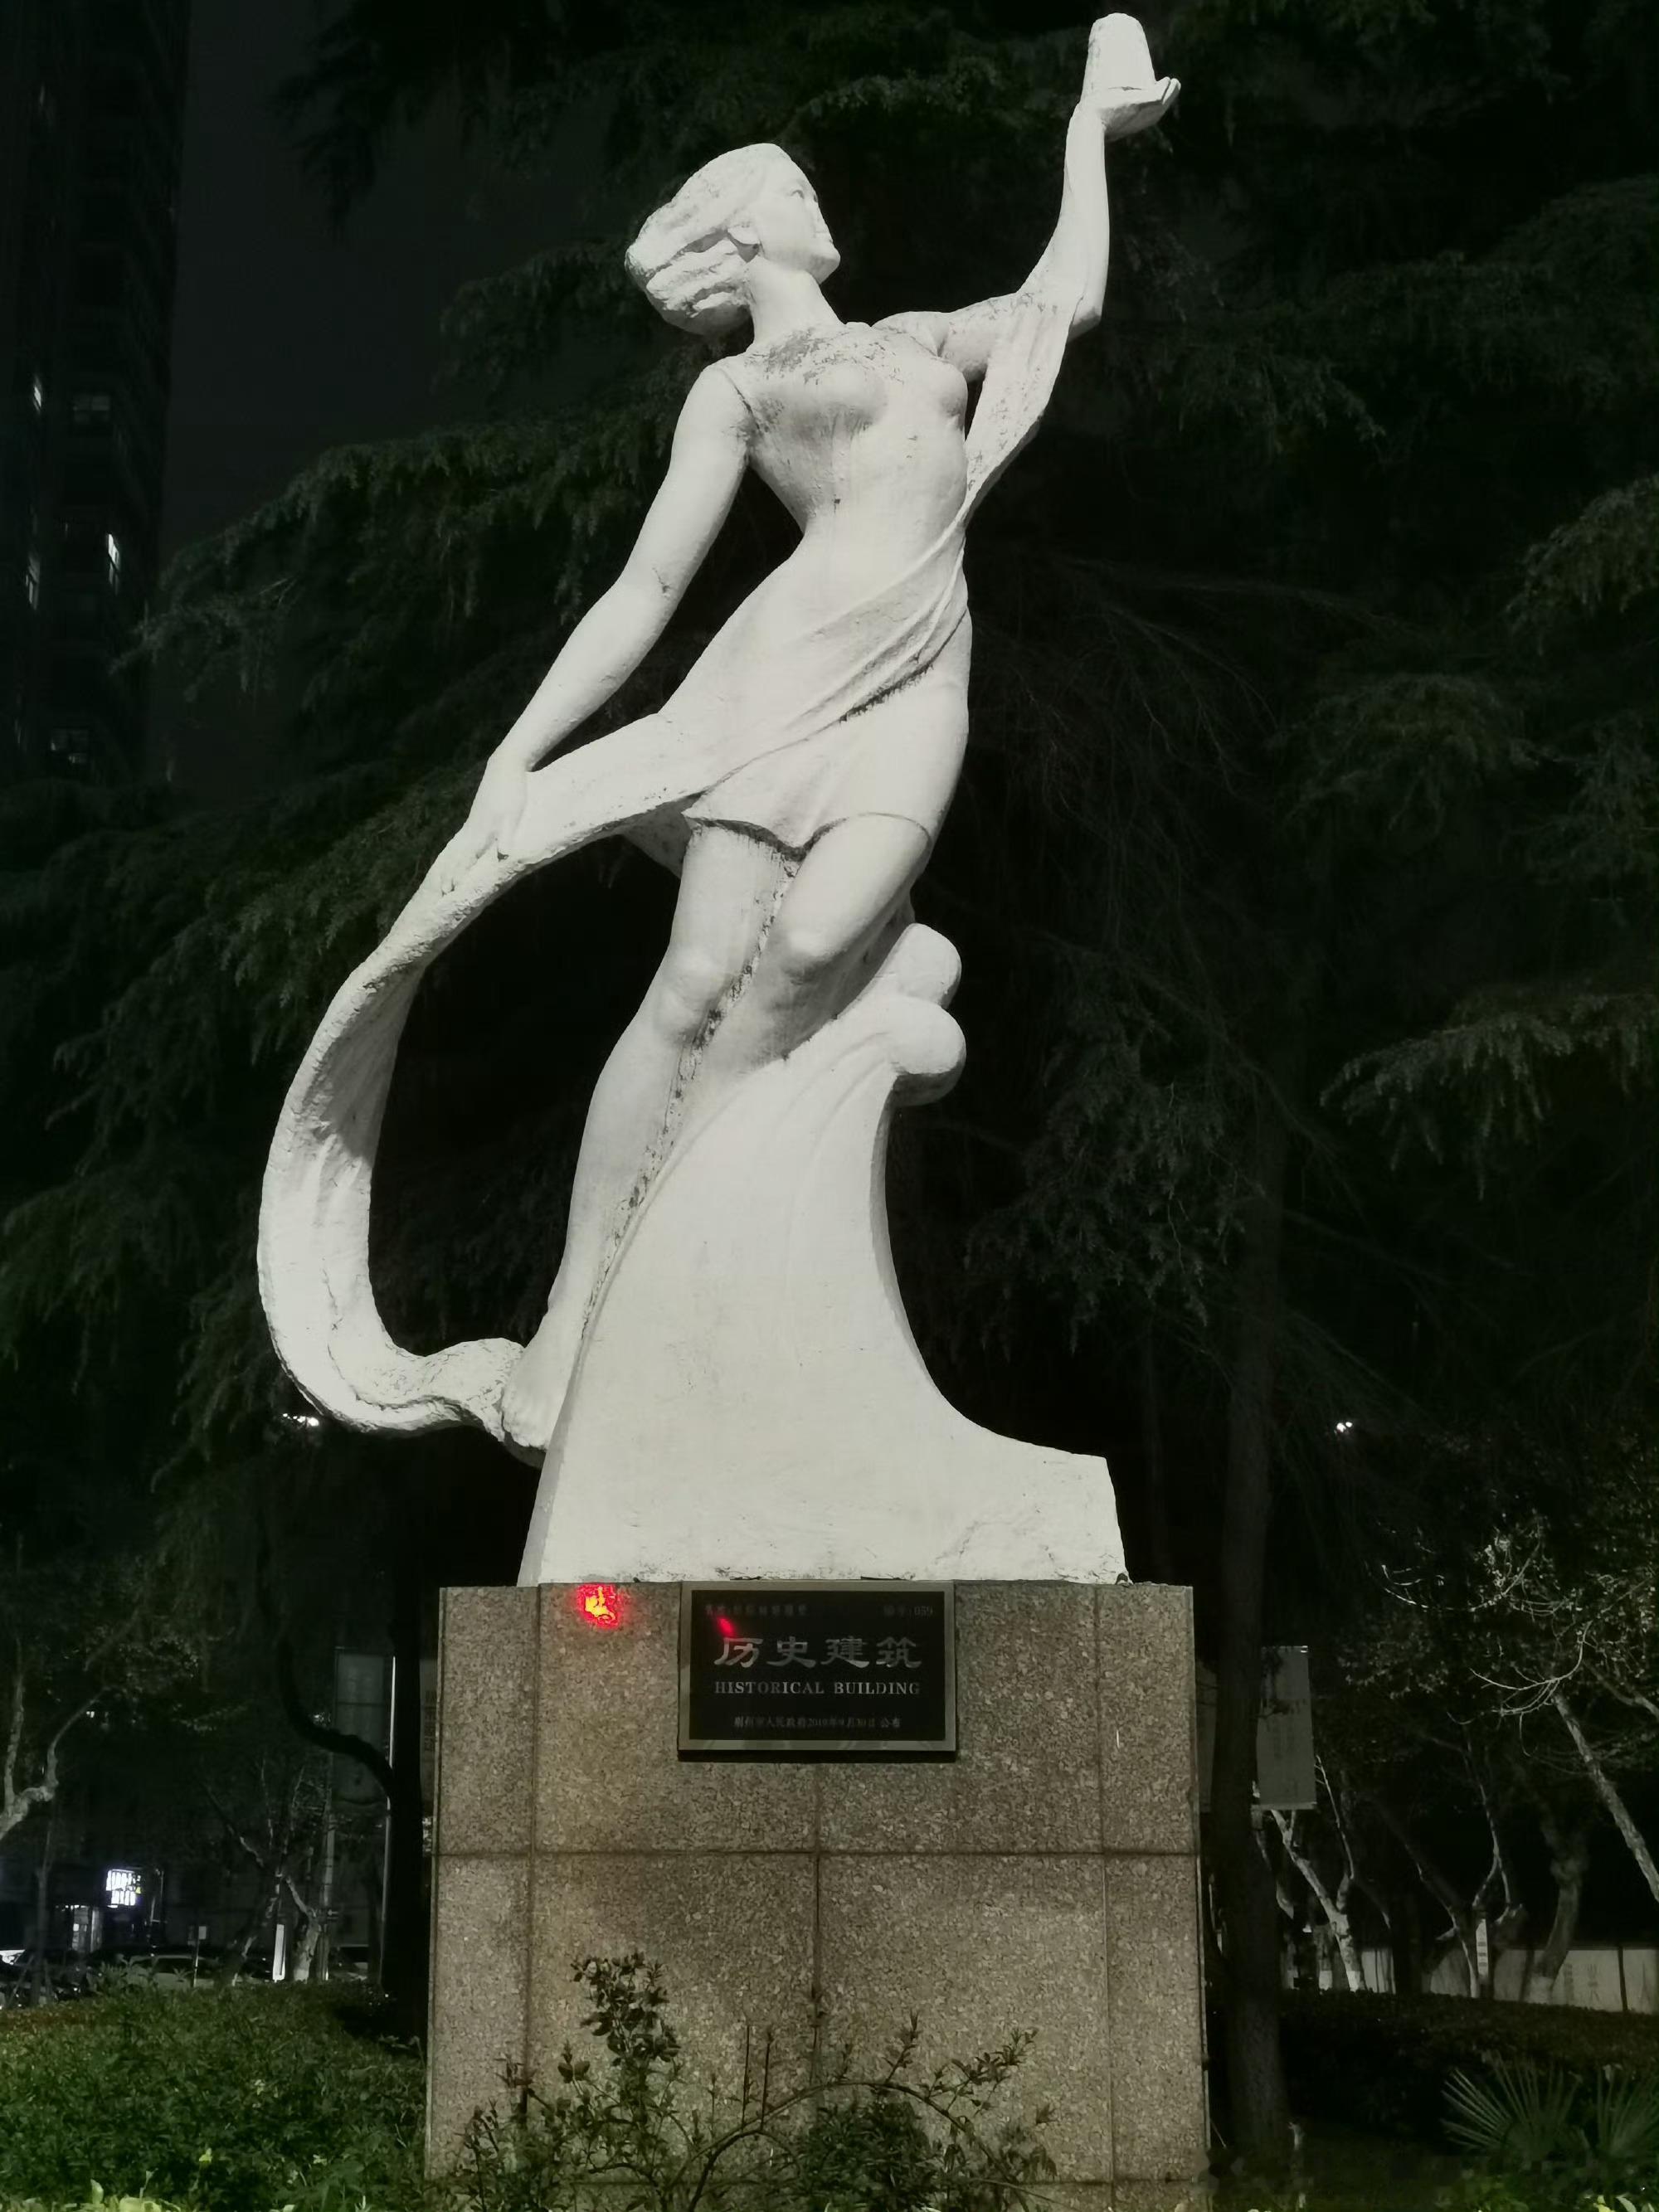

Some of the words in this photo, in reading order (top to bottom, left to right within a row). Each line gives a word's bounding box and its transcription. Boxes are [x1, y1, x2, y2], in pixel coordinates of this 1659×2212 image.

[713, 1636, 922, 1669] 历史建筑
[714, 1681, 825, 1694] HISTORICAL
[834, 1681, 921, 1694] BUILDING
